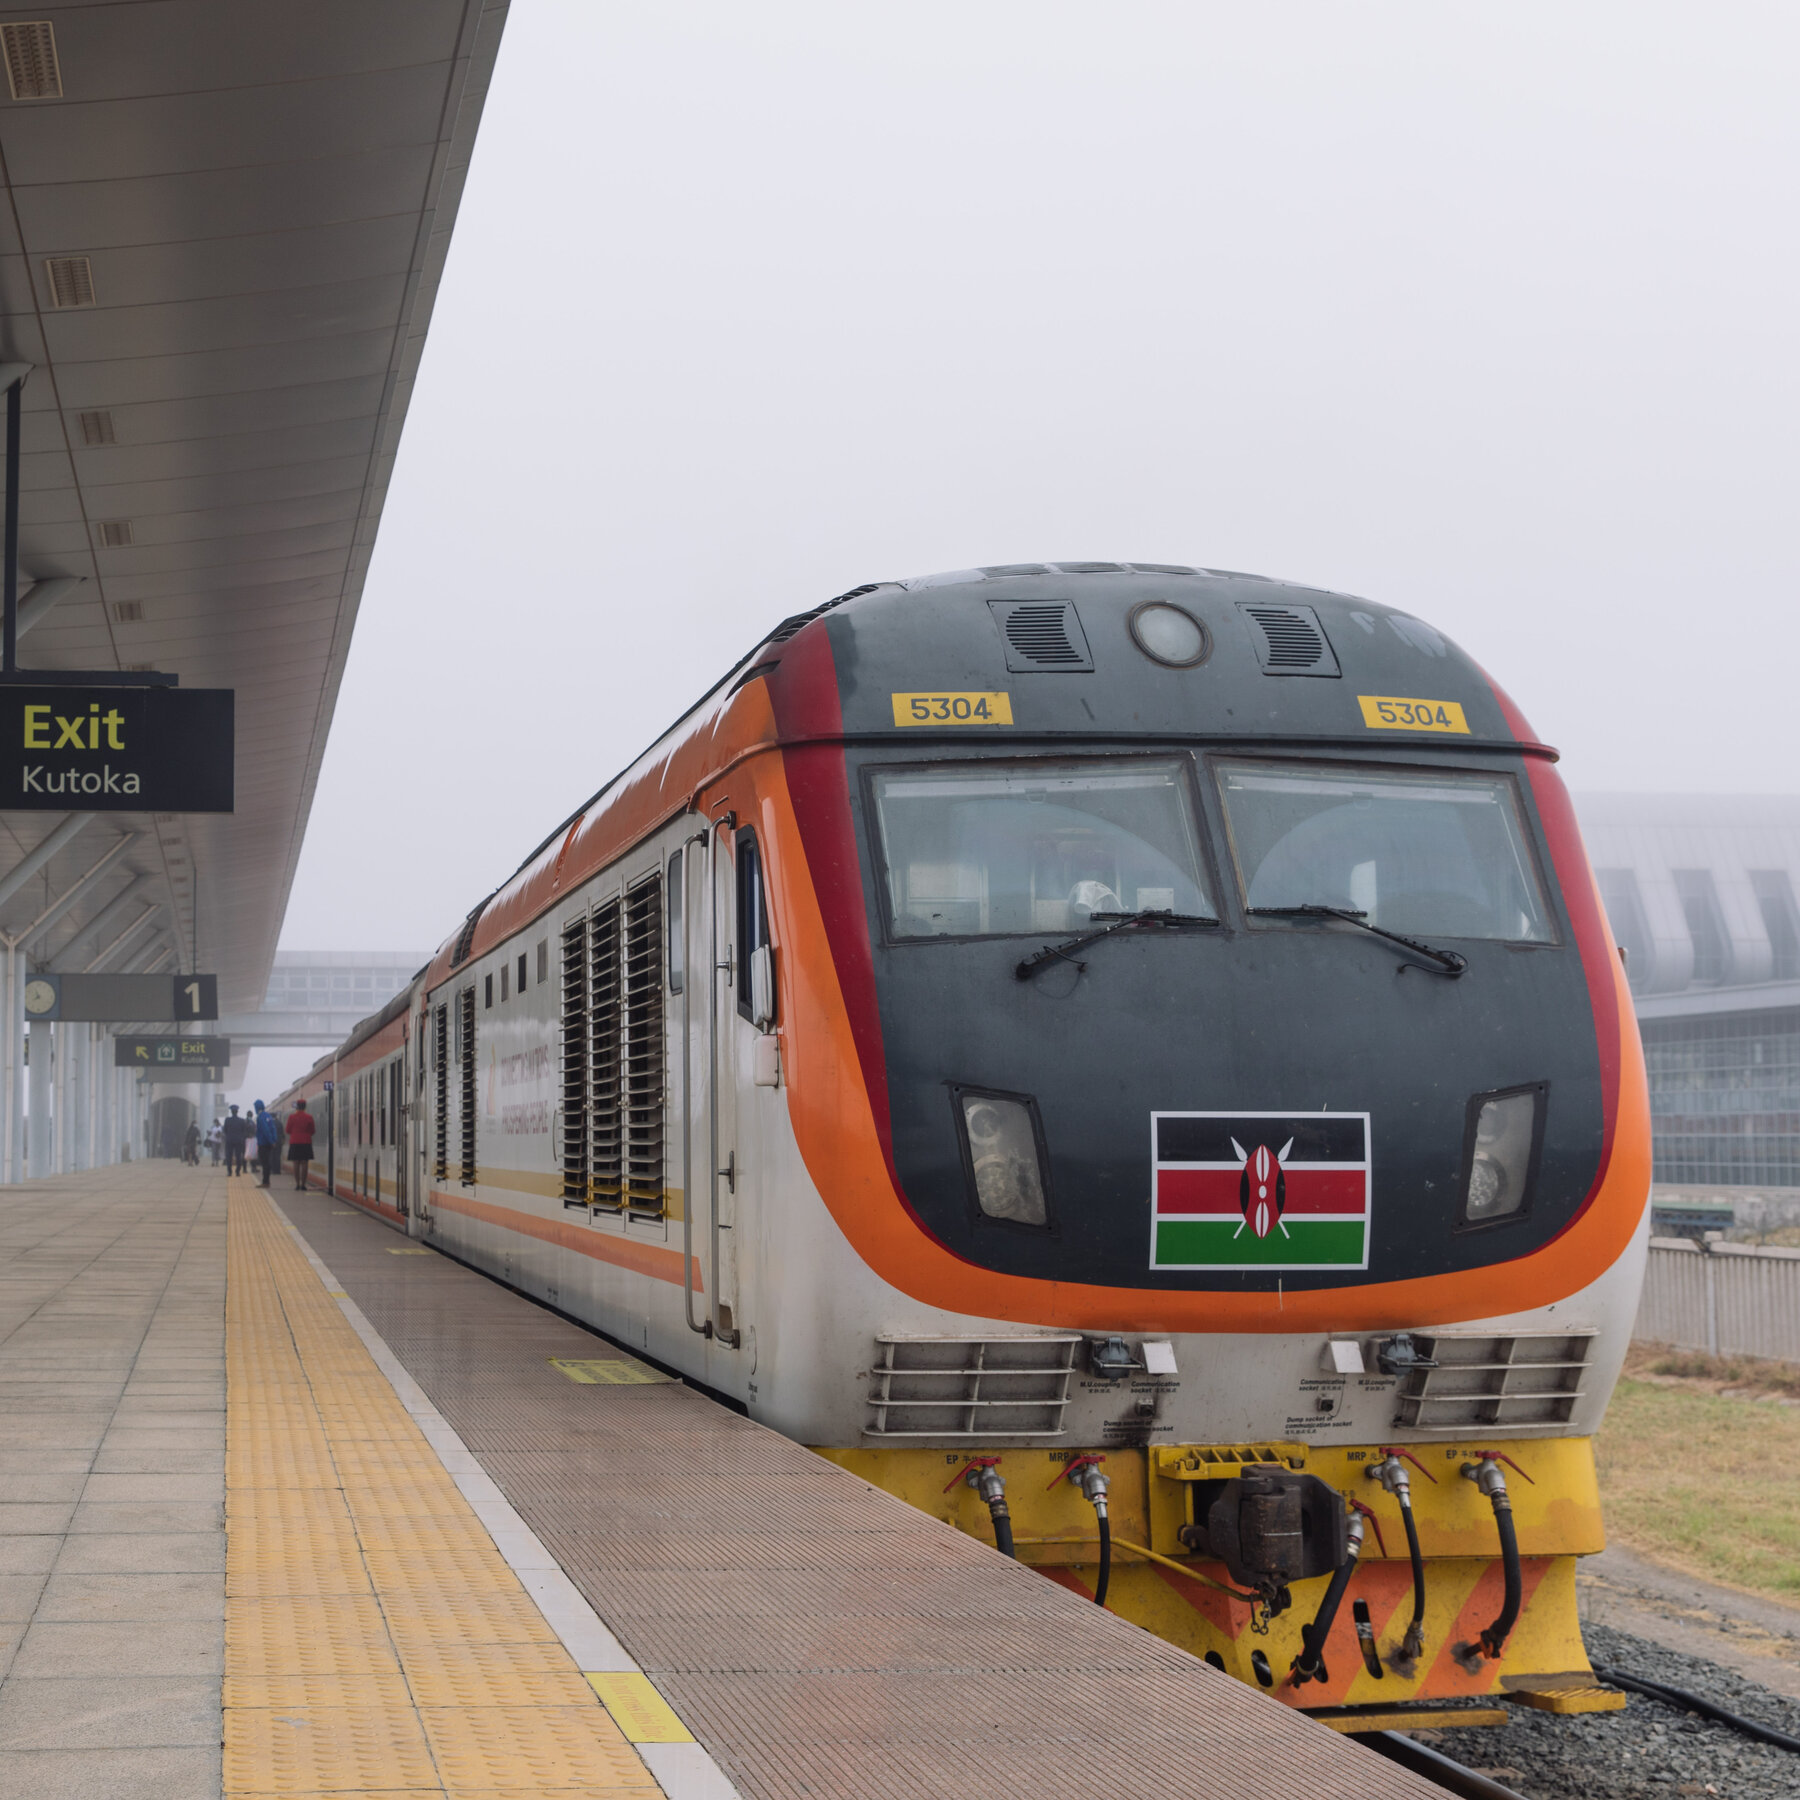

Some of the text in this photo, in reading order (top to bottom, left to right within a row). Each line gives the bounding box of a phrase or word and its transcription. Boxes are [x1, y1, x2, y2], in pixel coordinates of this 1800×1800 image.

[910, 697, 992, 720] 5304
[1376, 701, 1452, 727] 5304
[23, 703, 125, 750] Exit
[22, 764, 141, 794] Kutoka
[184, 982, 201, 1014] 1
[181, 1042, 206, 1054] Exit
[181, 1056, 209, 1064] Kutoka
[207, 1066, 215, 1080] 1
[1131, 1380, 1181, 1388] Communication
[1332, 1420, 1353, 1428] socket
[946, 1454, 959, 1465] EP
[1049, 1452, 1070, 1462] MRP
[1347, 1451, 1367, 1461] MRP
[1446, 1449, 1458, 1459] EP
